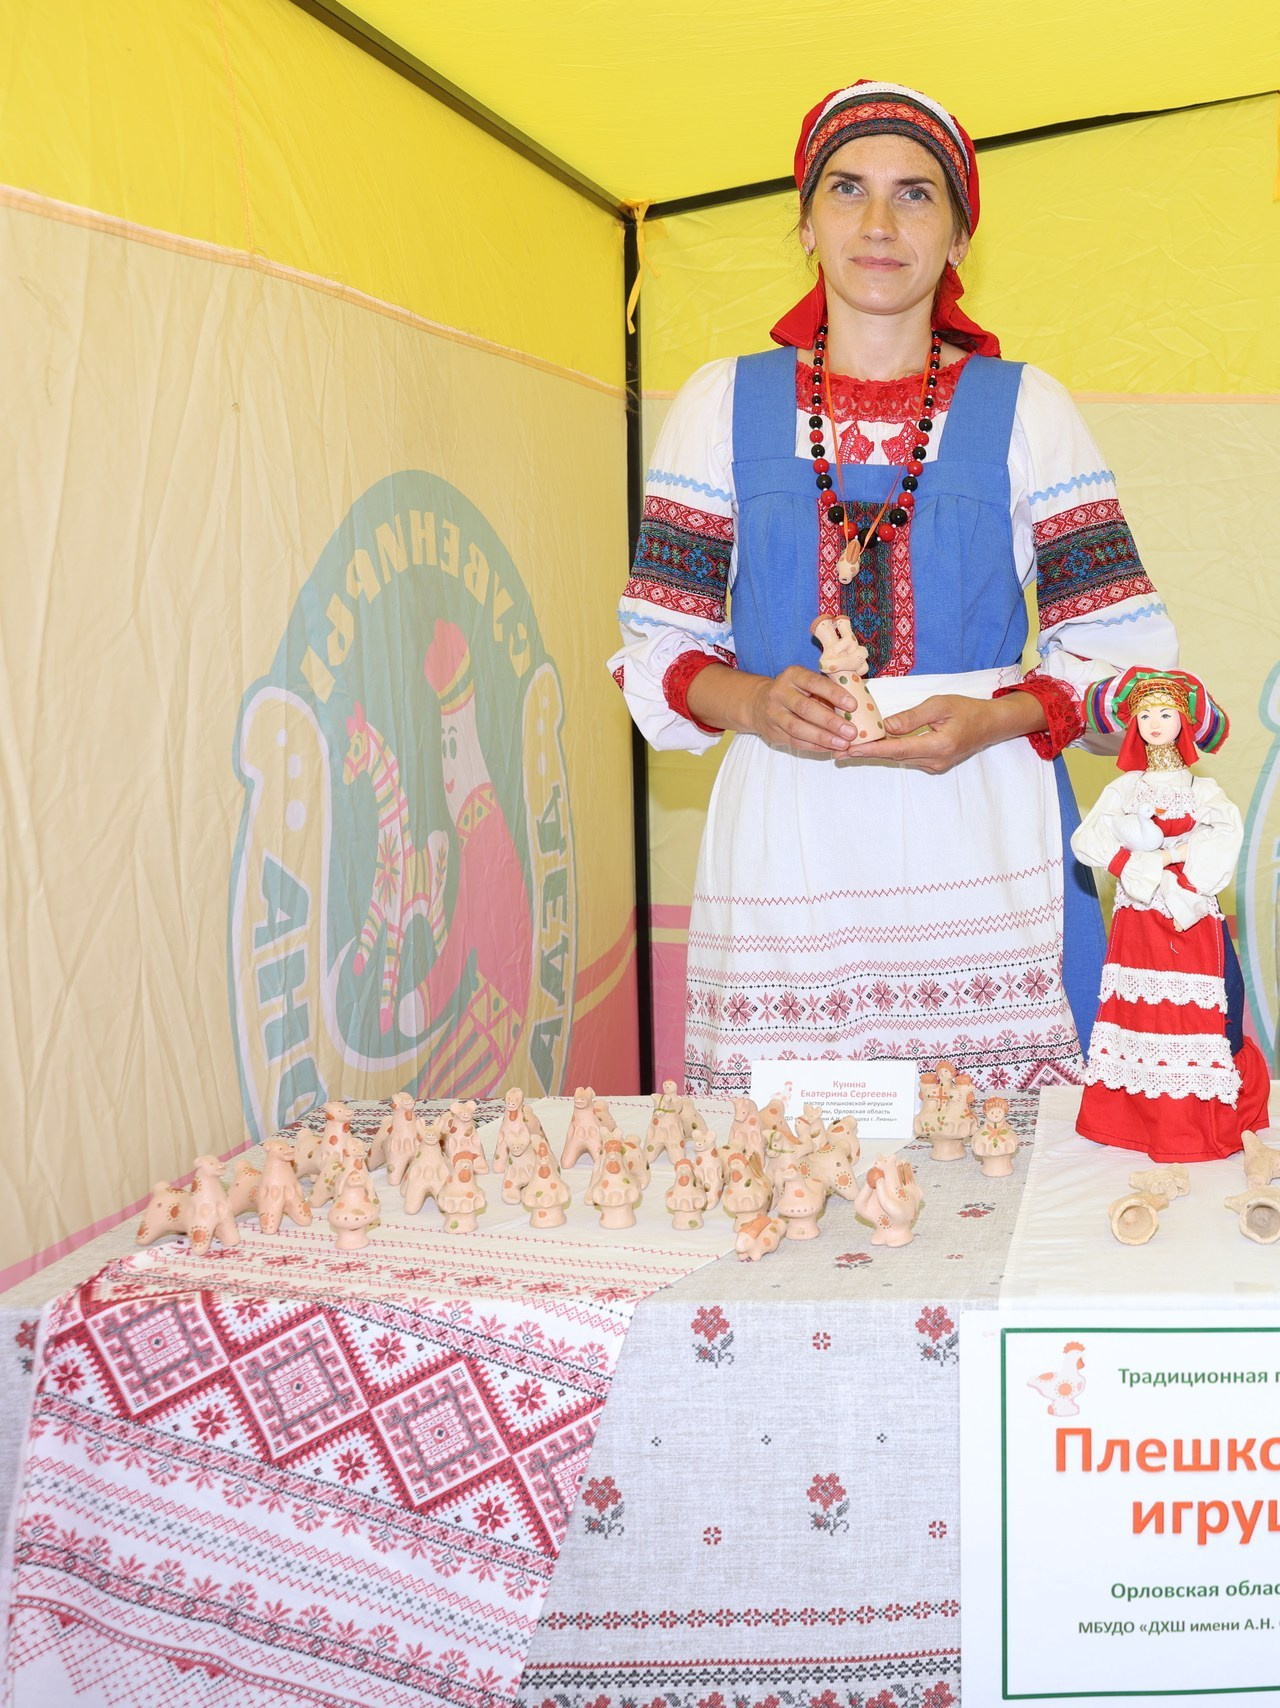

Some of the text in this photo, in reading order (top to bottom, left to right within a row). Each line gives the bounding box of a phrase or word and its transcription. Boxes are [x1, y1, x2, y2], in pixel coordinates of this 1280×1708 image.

[800, 1090, 897, 1099] Екатерина Сергеевна
[833, 1080, 866, 1089] Кунина
[1117, 1367, 1269, 1389] Традиционная
[1110, 1582, 1220, 1603] Орловская
[1078, 1620, 1136, 1637] МБУДО
[1138, 1620, 1186, 1637] «ДХШ
[1189, 1621, 1240, 1633] имени
[1243, 1617, 1275, 1631] А.Н.
